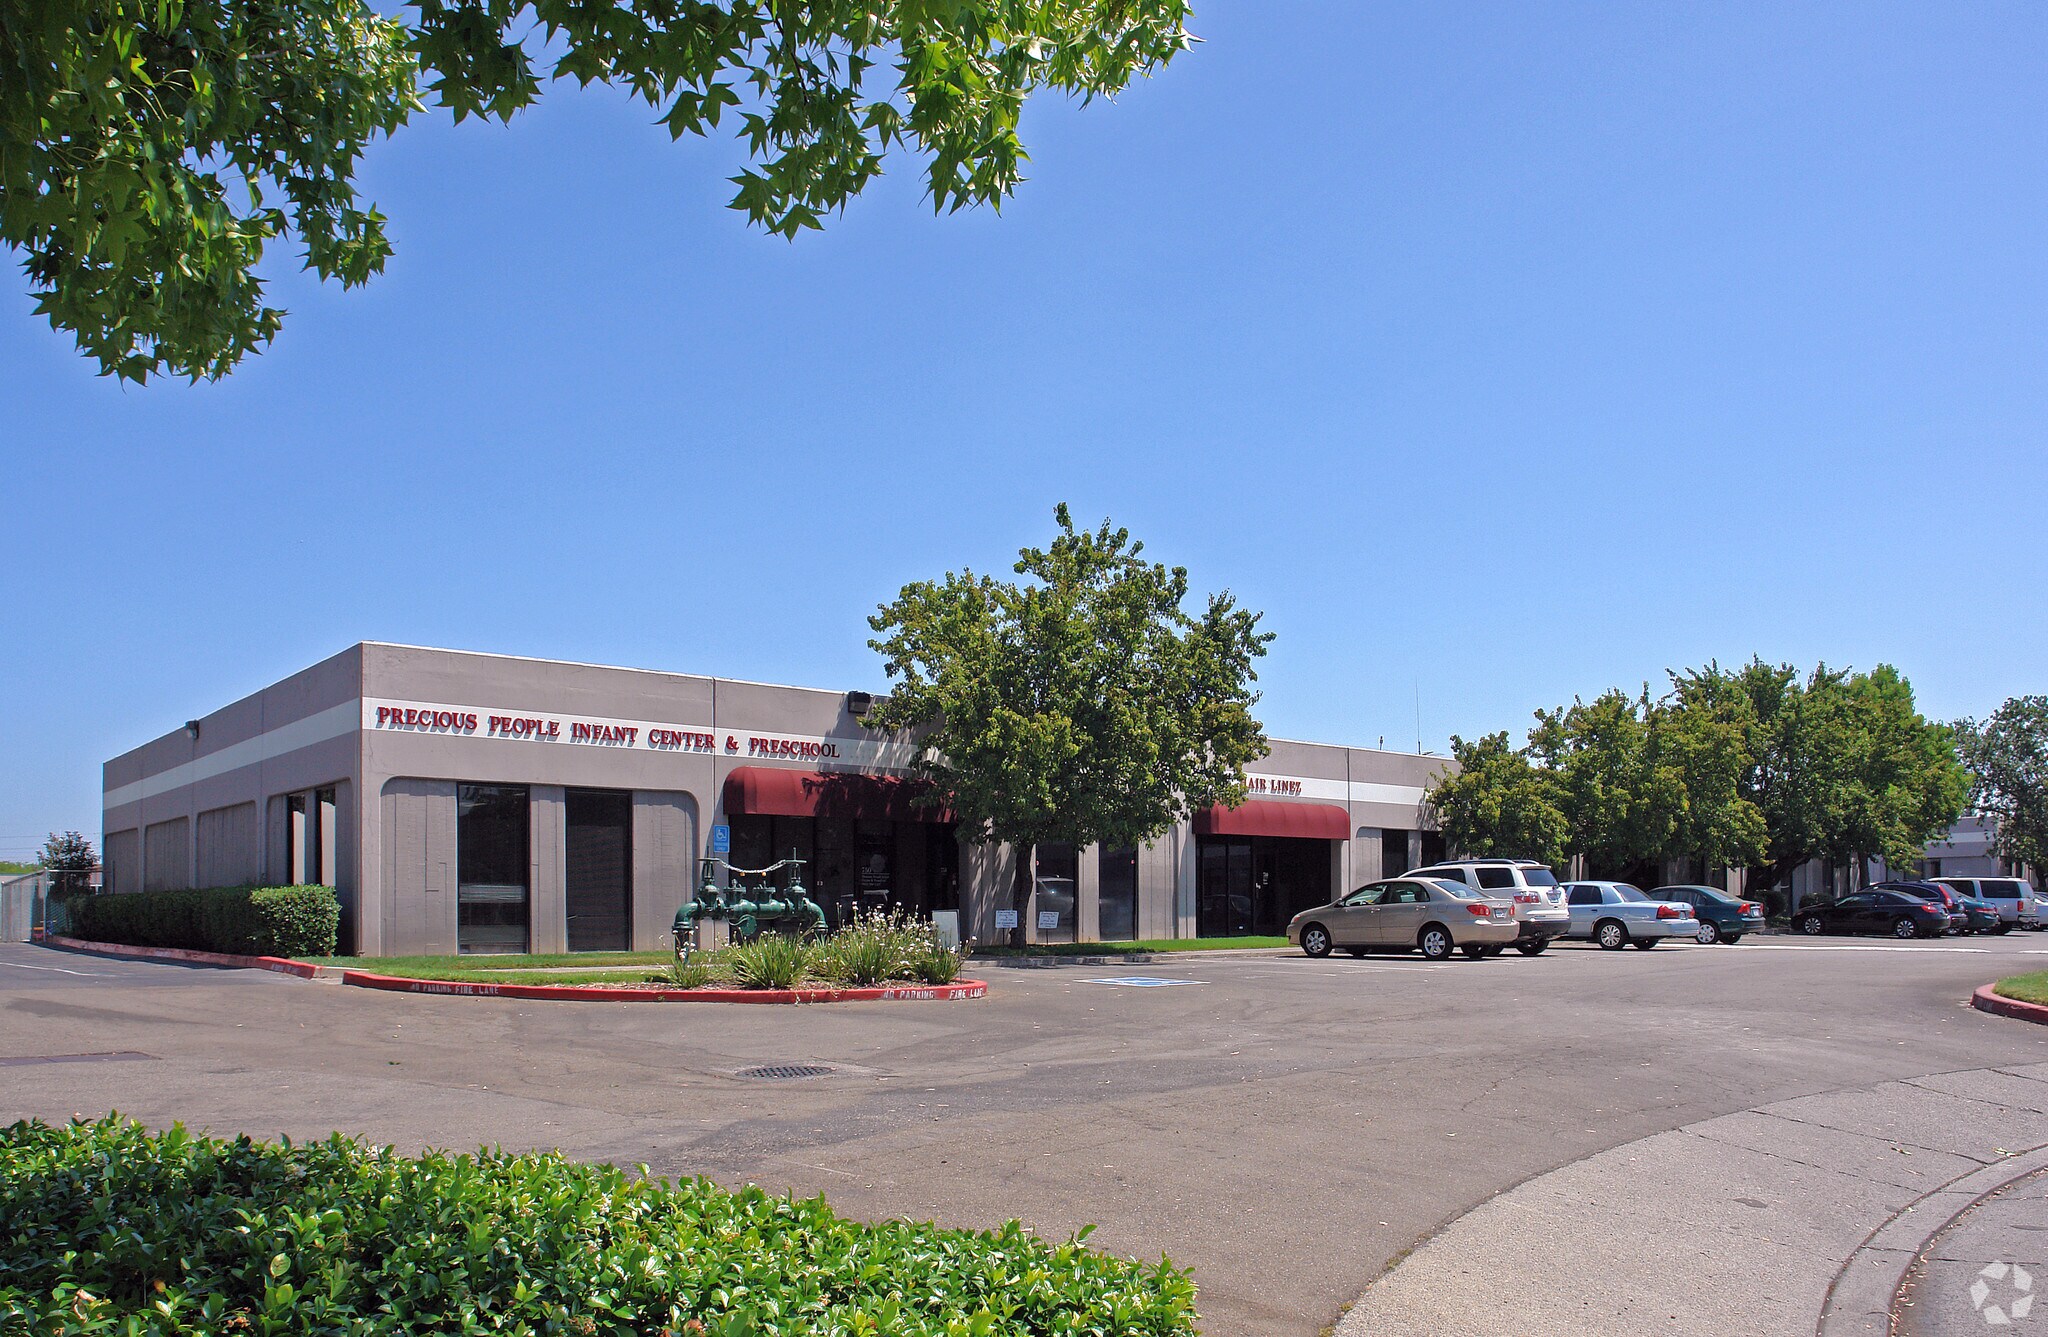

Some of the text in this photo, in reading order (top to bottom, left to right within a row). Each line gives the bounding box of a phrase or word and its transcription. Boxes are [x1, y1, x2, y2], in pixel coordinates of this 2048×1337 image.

[377, 706, 840, 758] PRECIOUS PEOPLE INFANT CENTER & PRESCHOOL
[1270, 779, 1301, 793] LINEZ
[455, 985, 473, 994] FIRE
[478, 986, 499, 995] LANE
[883, 989, 934, 999] NO PARKING
[949, 989, 967, 1000] FIRE
